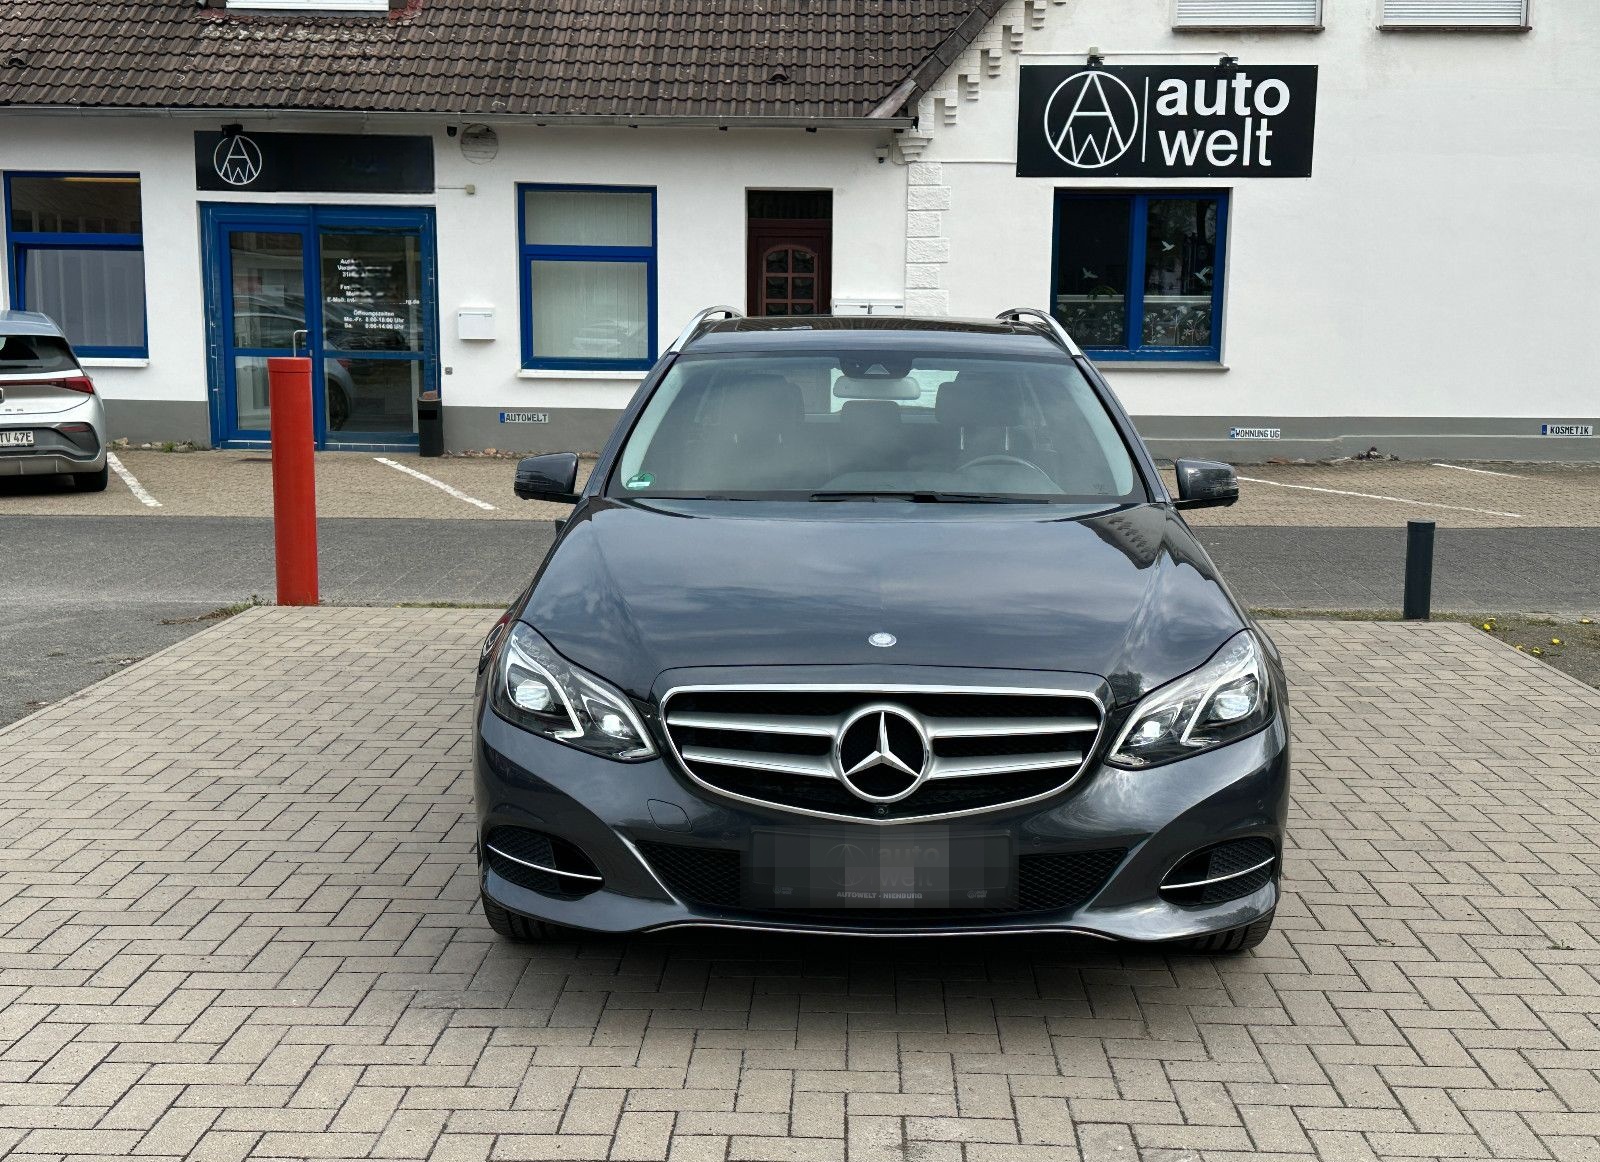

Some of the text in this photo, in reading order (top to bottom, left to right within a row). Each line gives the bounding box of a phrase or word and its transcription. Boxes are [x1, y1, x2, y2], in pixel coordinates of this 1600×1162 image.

[1156, 72, 1290, 116] auto
[1158, 117, 1273, 167] welt
[353, 309, 394, 317] Öffnungszeiten
[505, 413, 548, 423] AUTOWELT
[1235, 429, 1280, 438] WOHNUNG UG
[1550, 426, 1589, 435] KOSMETIK
[14, 432, 32, 443] 47E
[878, 845, 940, 864] auto
[836, 891, 923, 900] AUTOWELT NIENBURG
